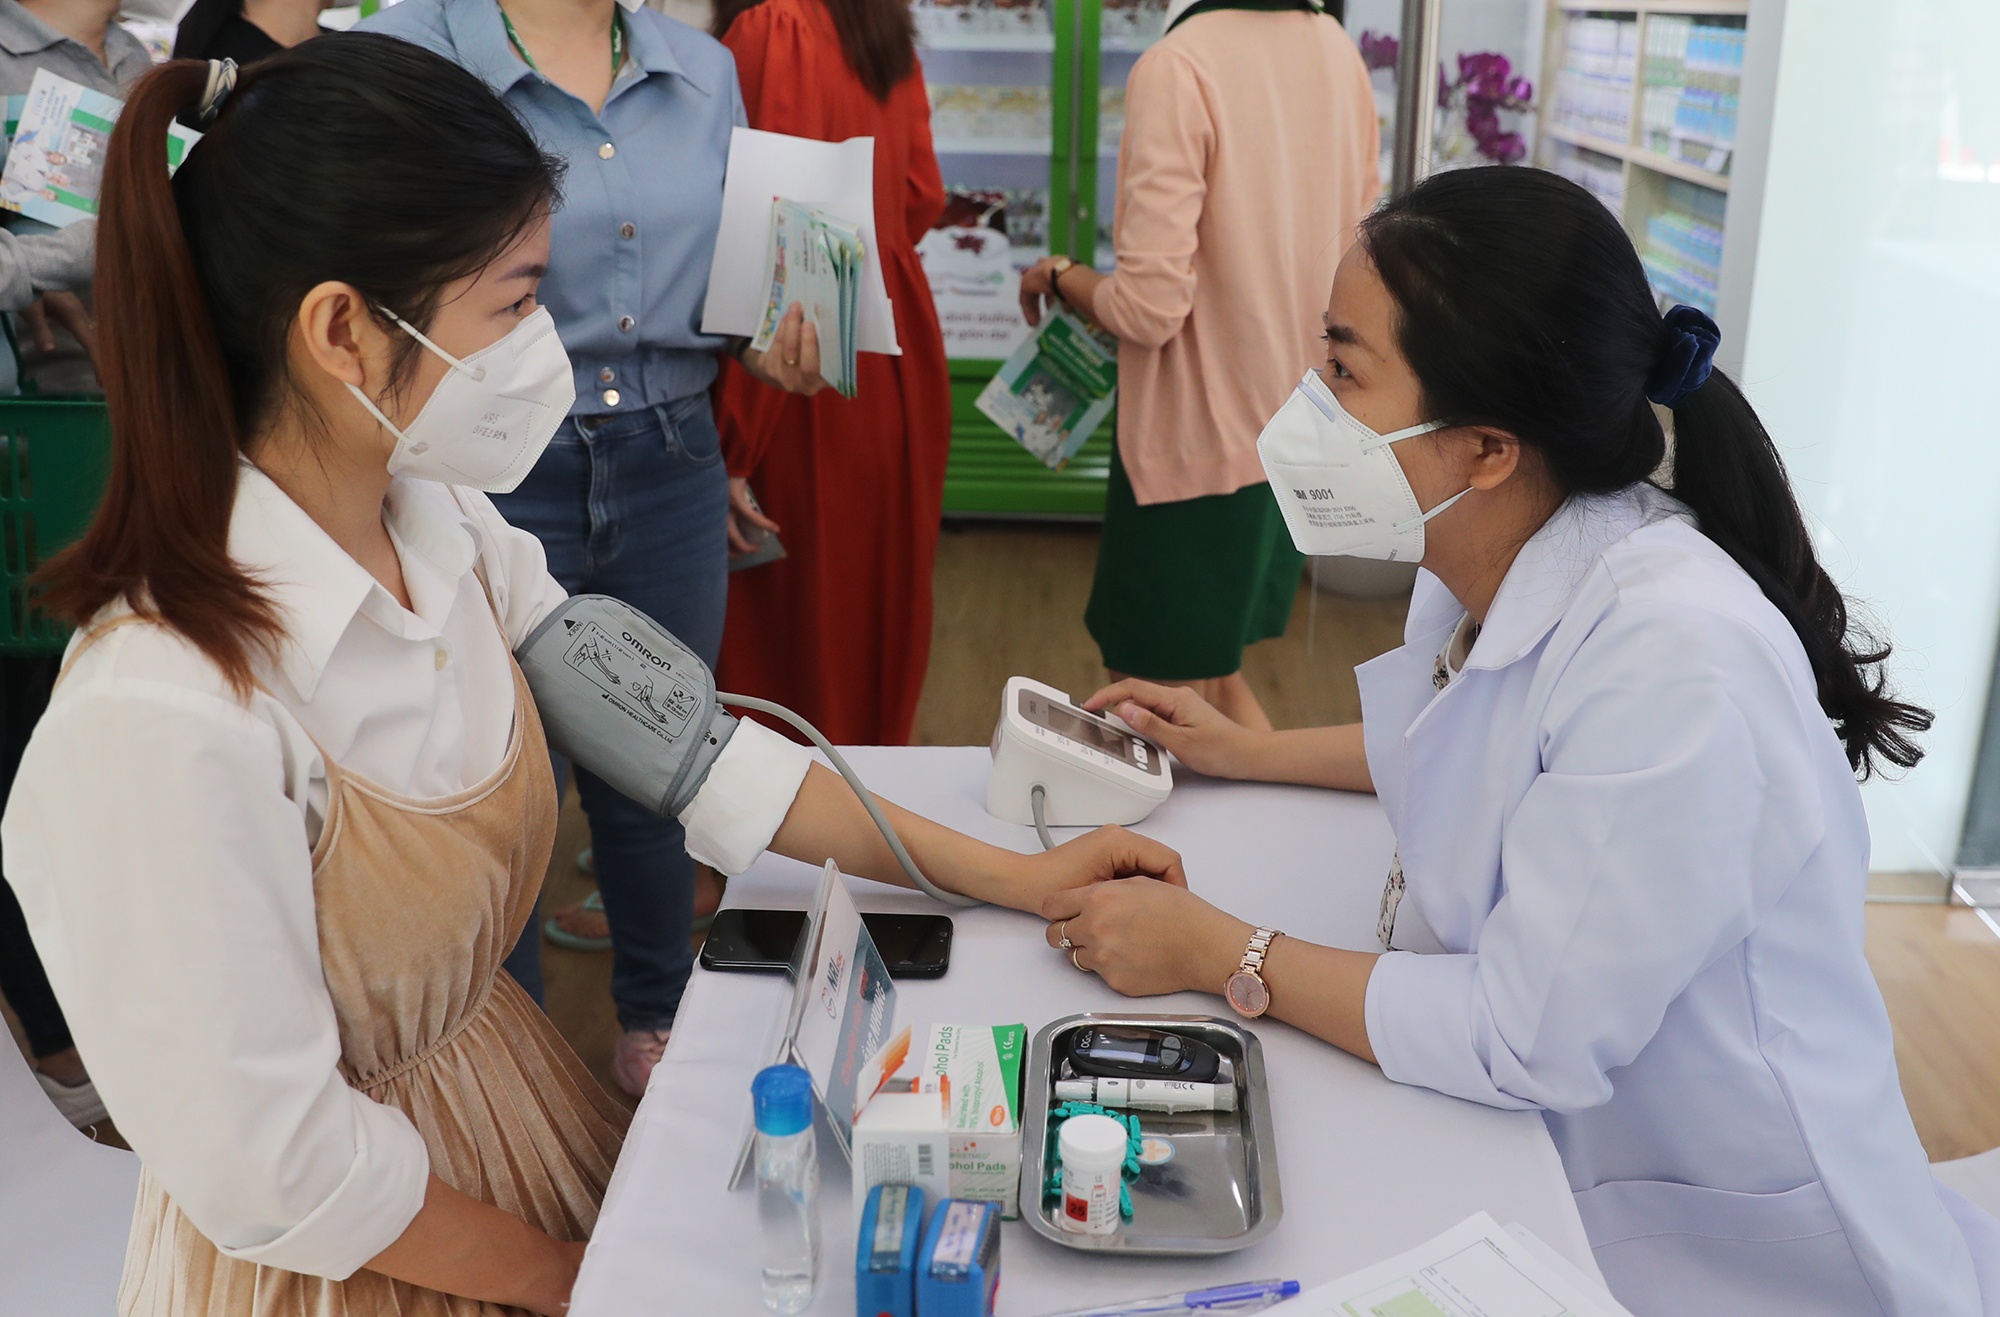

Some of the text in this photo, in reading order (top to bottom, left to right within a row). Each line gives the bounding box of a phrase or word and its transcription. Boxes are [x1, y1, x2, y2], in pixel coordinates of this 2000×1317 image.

[1309, 488, 1334, 500] 9001
[566, 621, 583, 638] INDEX
[608, 697, 628, 714] OMRON
[626, 709, 658, 734] HEALTHCARE
[870, 980, 886, 1037] NHUNG
[933, 1026, 953, 1076] ohol Pads
[949, 1162, 1006, 1170] ohol Pads
